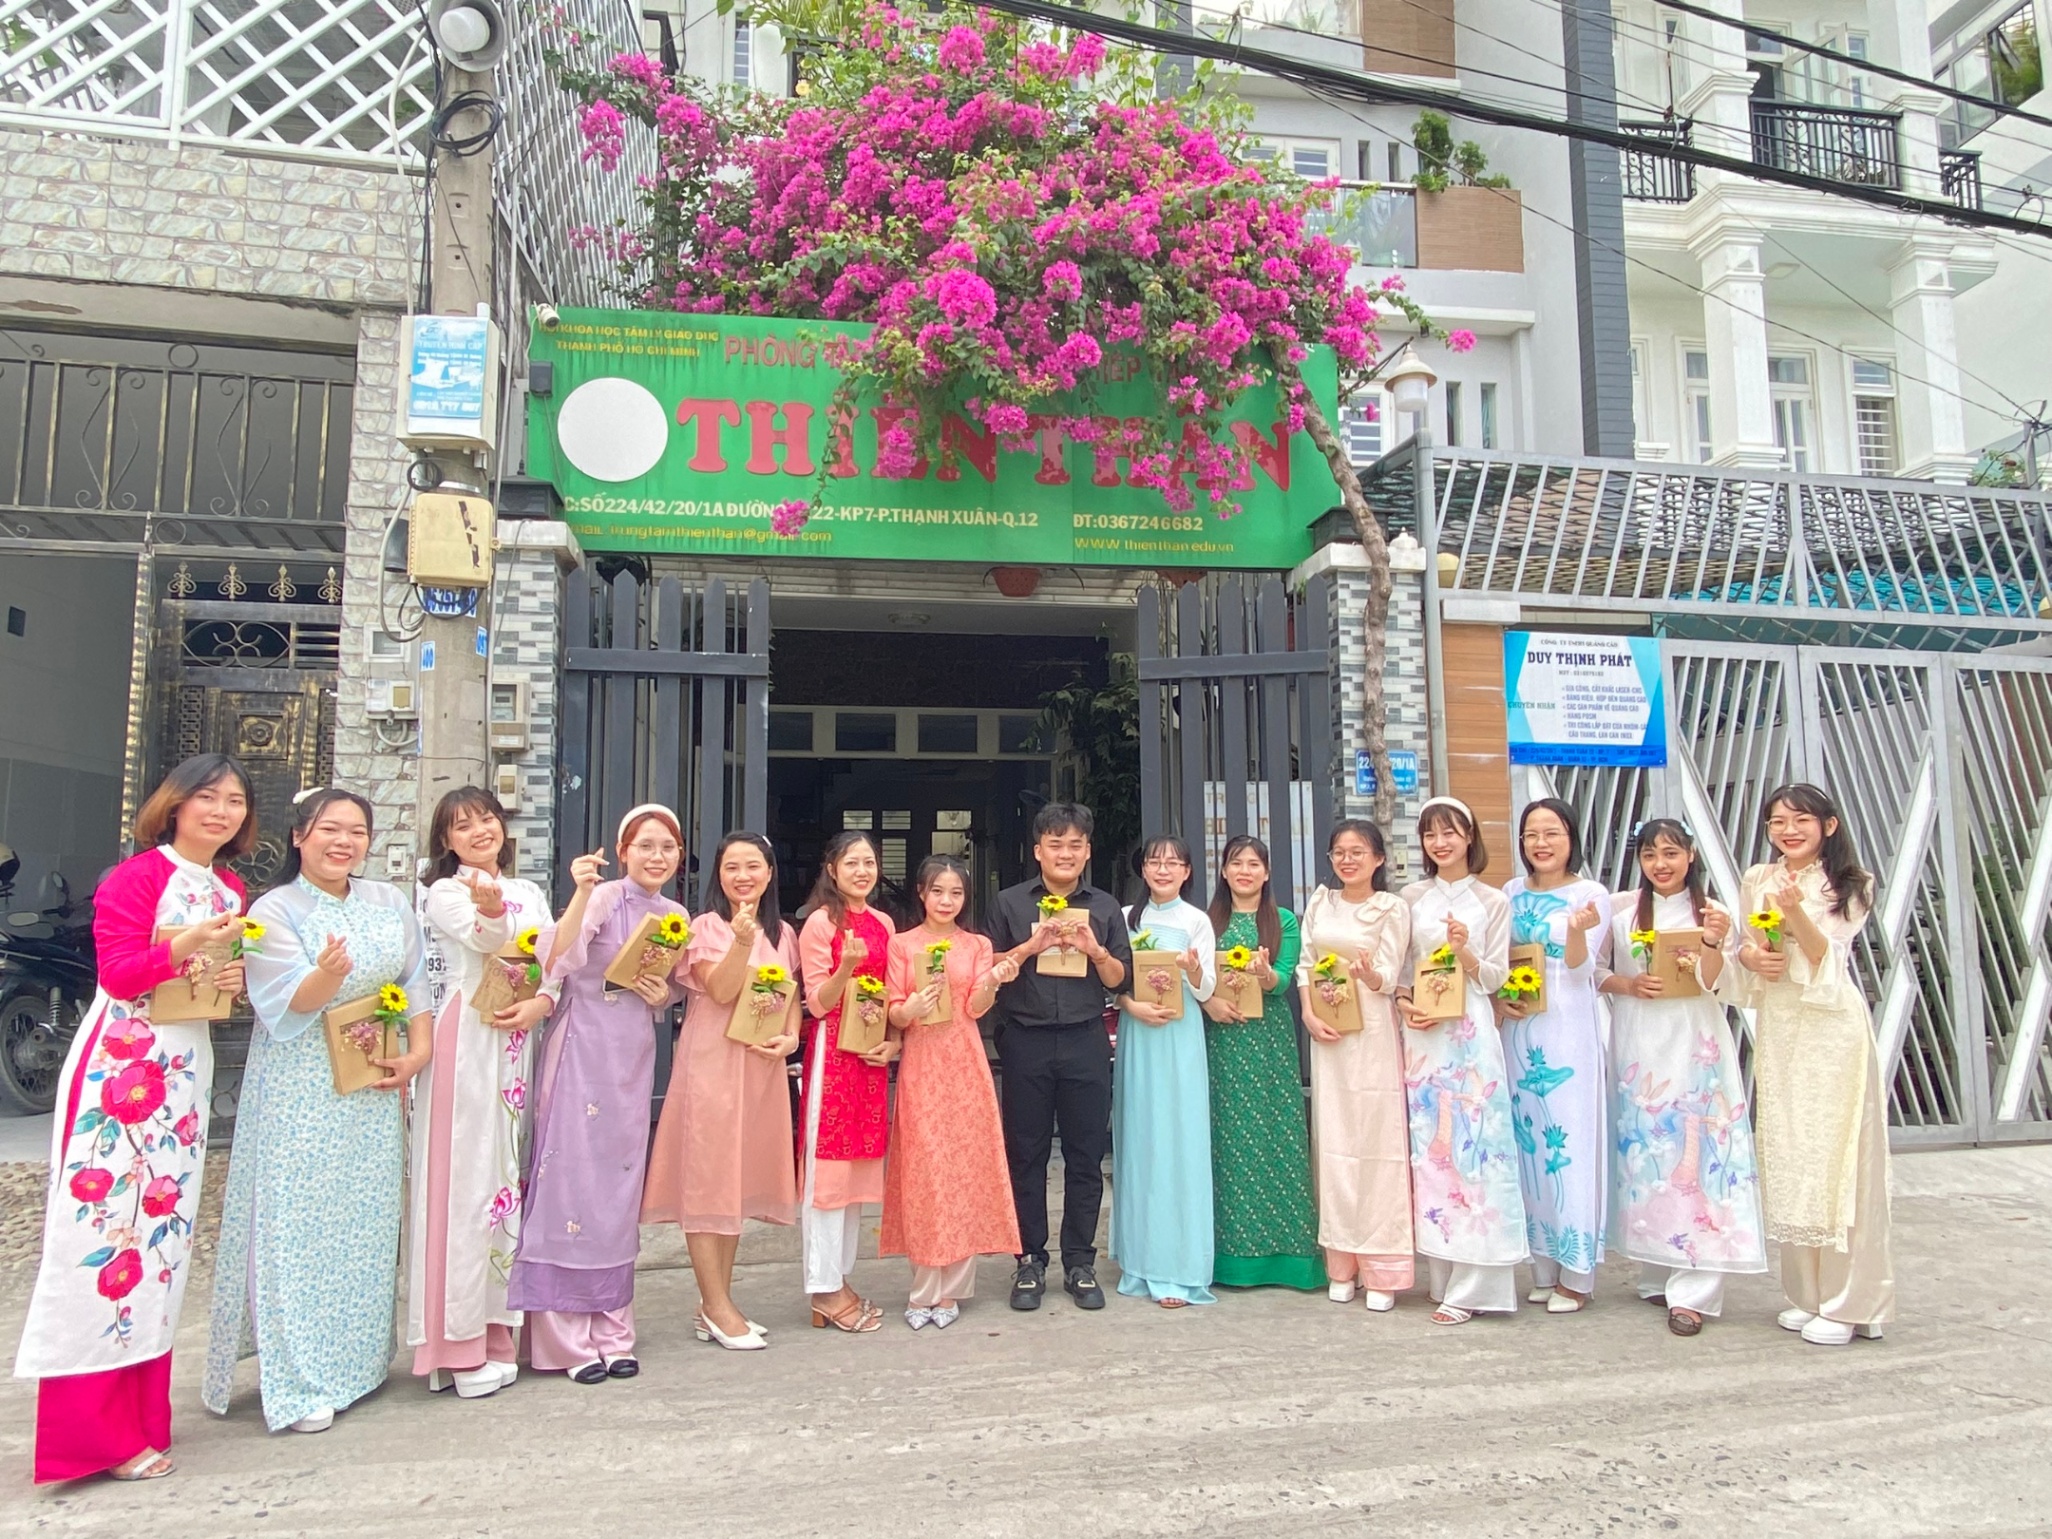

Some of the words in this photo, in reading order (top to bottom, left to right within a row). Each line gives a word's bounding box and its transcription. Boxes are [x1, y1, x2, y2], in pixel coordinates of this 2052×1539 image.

[724, 332, 817, 368] PHÒNG
[1527, 652, 1552, 664] DUY
[1556, 653, 1596, 667] THỊNH
[1600, 652, 1632, 667] PHÁT
